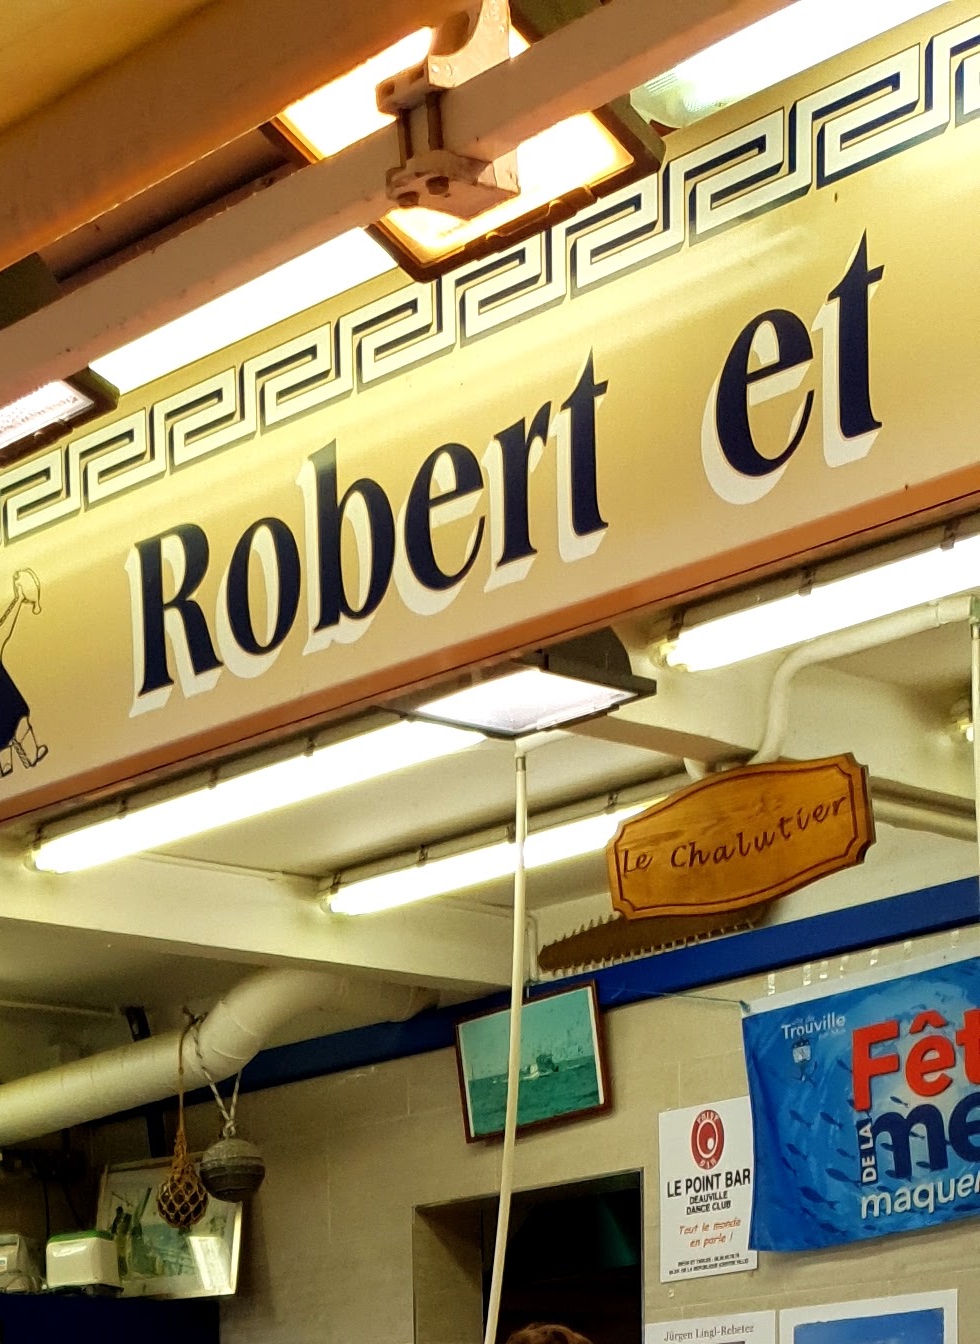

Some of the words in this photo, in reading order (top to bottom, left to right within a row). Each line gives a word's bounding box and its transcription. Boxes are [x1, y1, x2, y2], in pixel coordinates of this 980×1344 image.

[128, 348, 610, 710] Robert
[710, 231, 884, 492] et
[622, 850, 653, 877] Le
[670, 796, 849, 868] Chalutier
[781, 1012, 846, 1040] Trouville
[861, 1118, 873, 1150] LA
[667, 1180, 682, 1198] LE
[685, 1173, 722, 1195] POINT
[725, 1168, 751, 1188] BAR
[862, 1154, 877, 1184] DE
[686, 1204, 710, 1216] DANCE
[712, 1200, 731, 1212] CLUB
[689, 1190, 728, 1205] DEAUVILLE
[679, 1224, 698, 1235] Tout
[702, 1222, 710, 1232] le
[664, 1328, 693, 1342] Jürgen
[695, 1323, 755, 1340] Lingl-Rebetez
